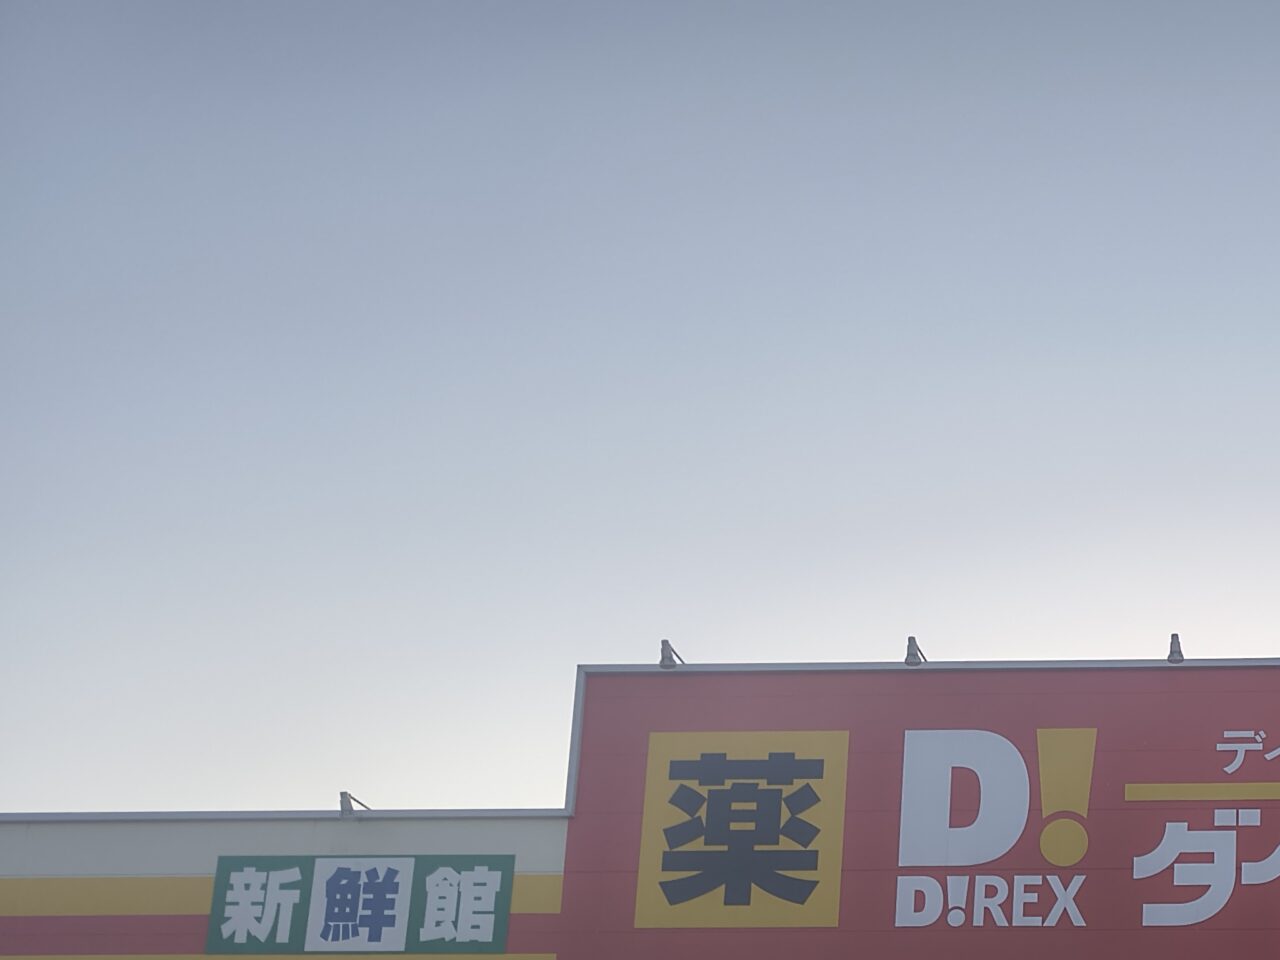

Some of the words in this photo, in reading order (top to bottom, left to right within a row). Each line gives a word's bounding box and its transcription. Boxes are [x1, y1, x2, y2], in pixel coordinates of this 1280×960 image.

[658, 752, 825, 906] 薬
[220, 866, 502, 943] 新鮮館
[894, 875, 1088, 928] D!REX
